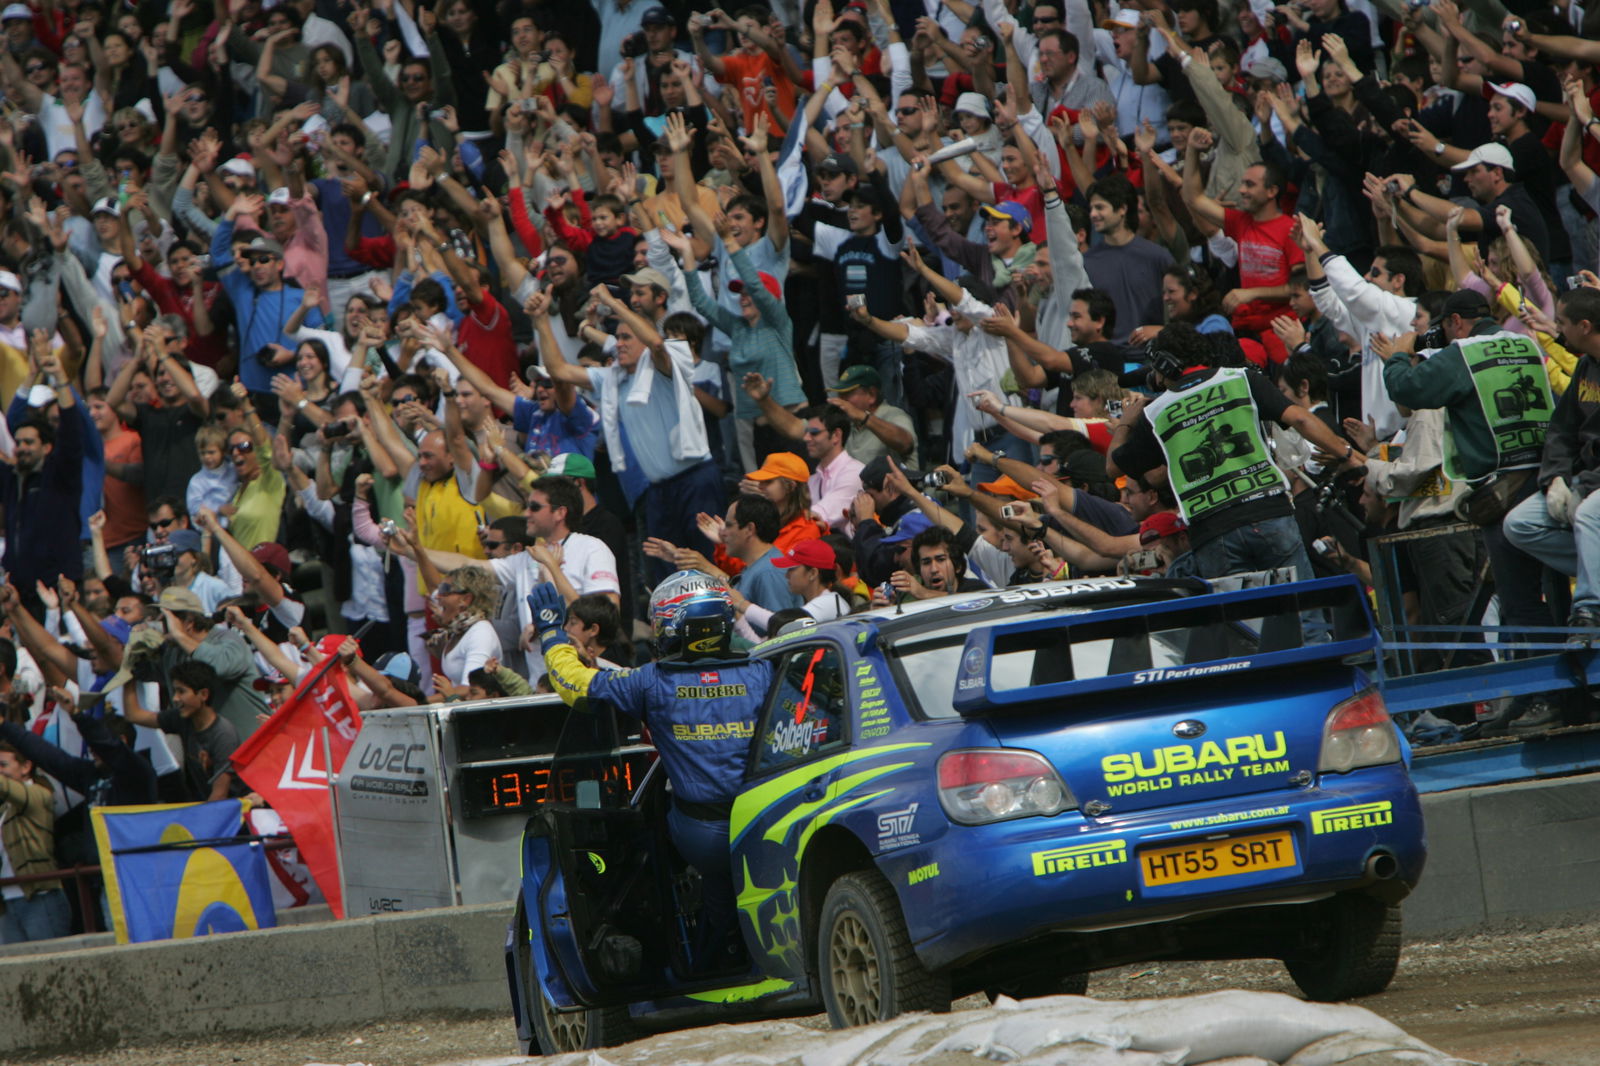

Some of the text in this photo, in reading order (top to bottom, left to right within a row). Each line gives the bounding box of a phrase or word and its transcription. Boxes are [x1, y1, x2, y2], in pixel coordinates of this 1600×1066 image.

[1481, 338, 1529, 356] 225
[1166, 385, 1228, 423] 224
[1182, 414, 1198, 427] Rally
[1188, 467, 1278, 515] 2006
[999, 580, 1136, 603] SUBARU
[1165, 661, 1252, 680] Performance
[676, 684, 747, 699] SOLBERG
[672, 720, 755, 736] SUBARU
[704, 733, 730, 741] RALLY
[772, 718, 815, 755] Solberg
[359, 742, 426, 774] WRC
[1101, 731, 1287, 783] SUBARU
[1107, 760, 1290, 797] WORLD RALLY TEAM
[1169, 805, 1290, 830] www.subaru.com.ar
[1310, 800, 1393, 835] PIRELLI
[1031, 839, 1127, 876] PIRELLI
[1148, 839, 1283, 880] HT55 SRT
[908, 862, 940, 886] MOTUL
